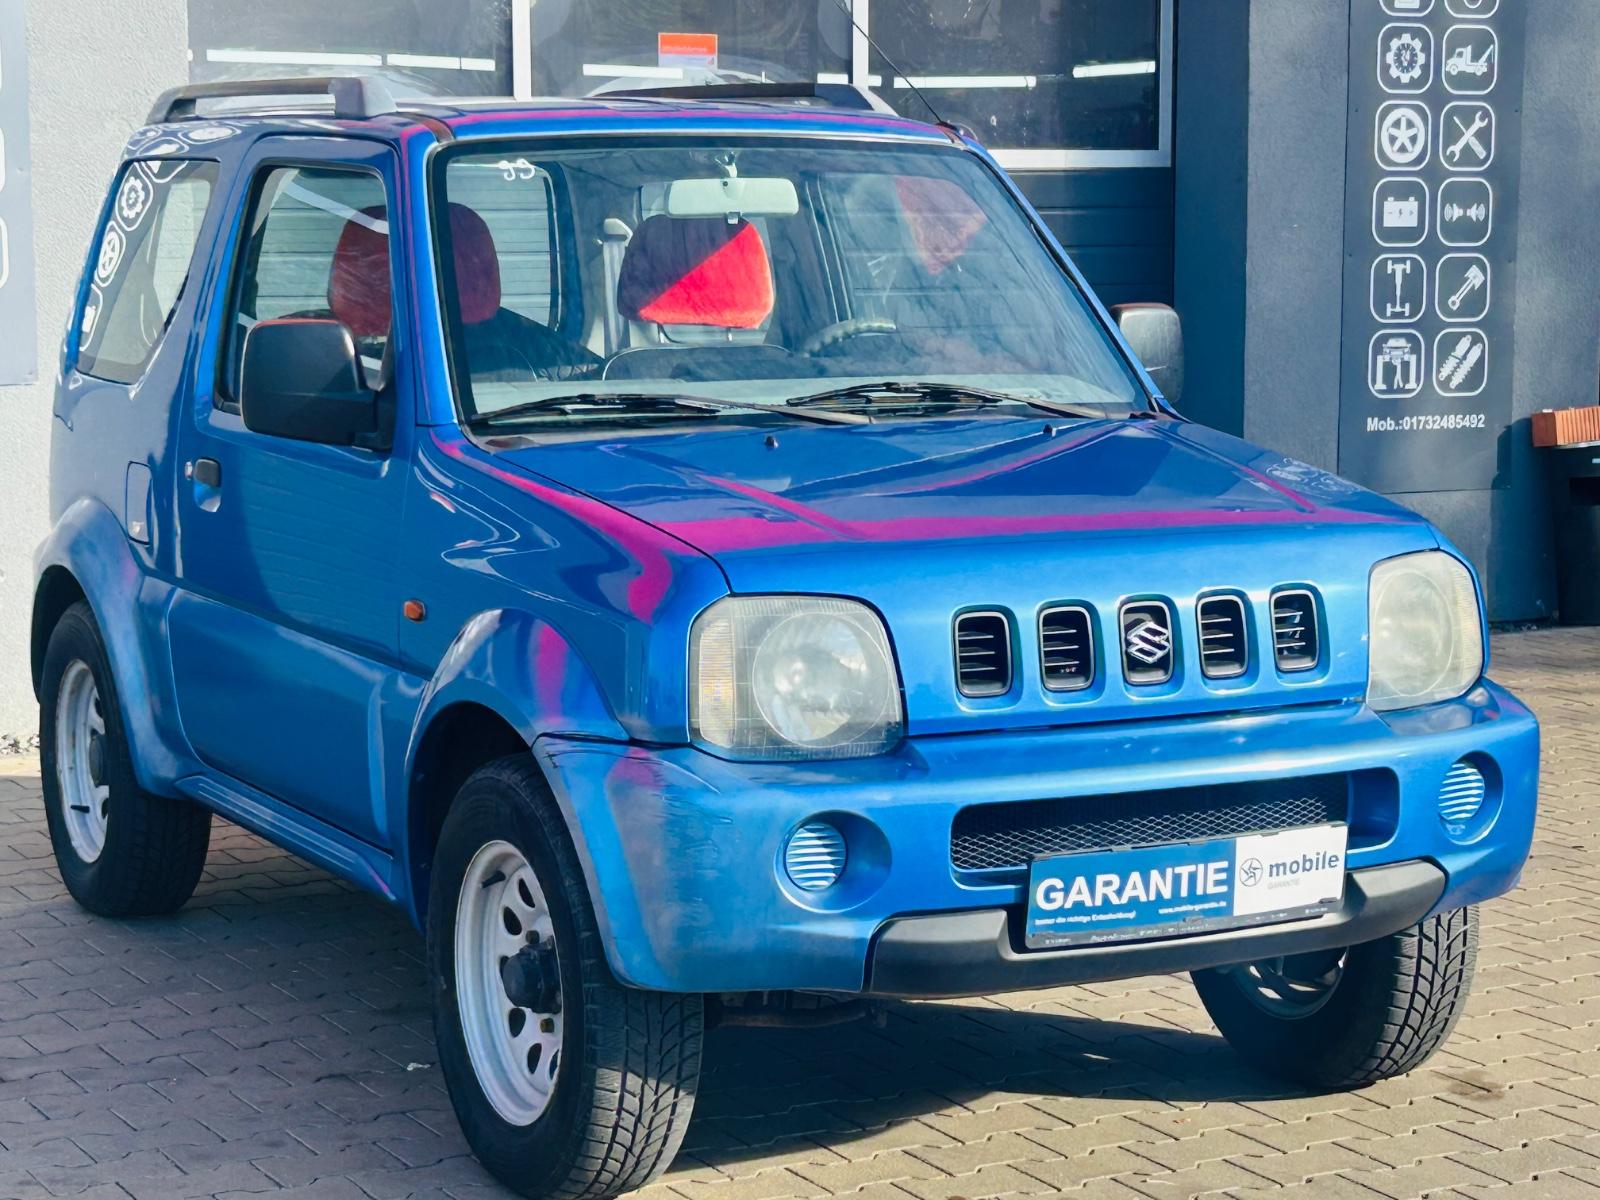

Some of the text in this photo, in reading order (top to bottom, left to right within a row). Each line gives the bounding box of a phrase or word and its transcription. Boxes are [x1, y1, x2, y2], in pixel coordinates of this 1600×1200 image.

[1366, 414, 1486, 432] Mob.:01732485492
[1268, 851, 1339, 878] mobile
[1036, 860, 1229, 911] GARANTIE
